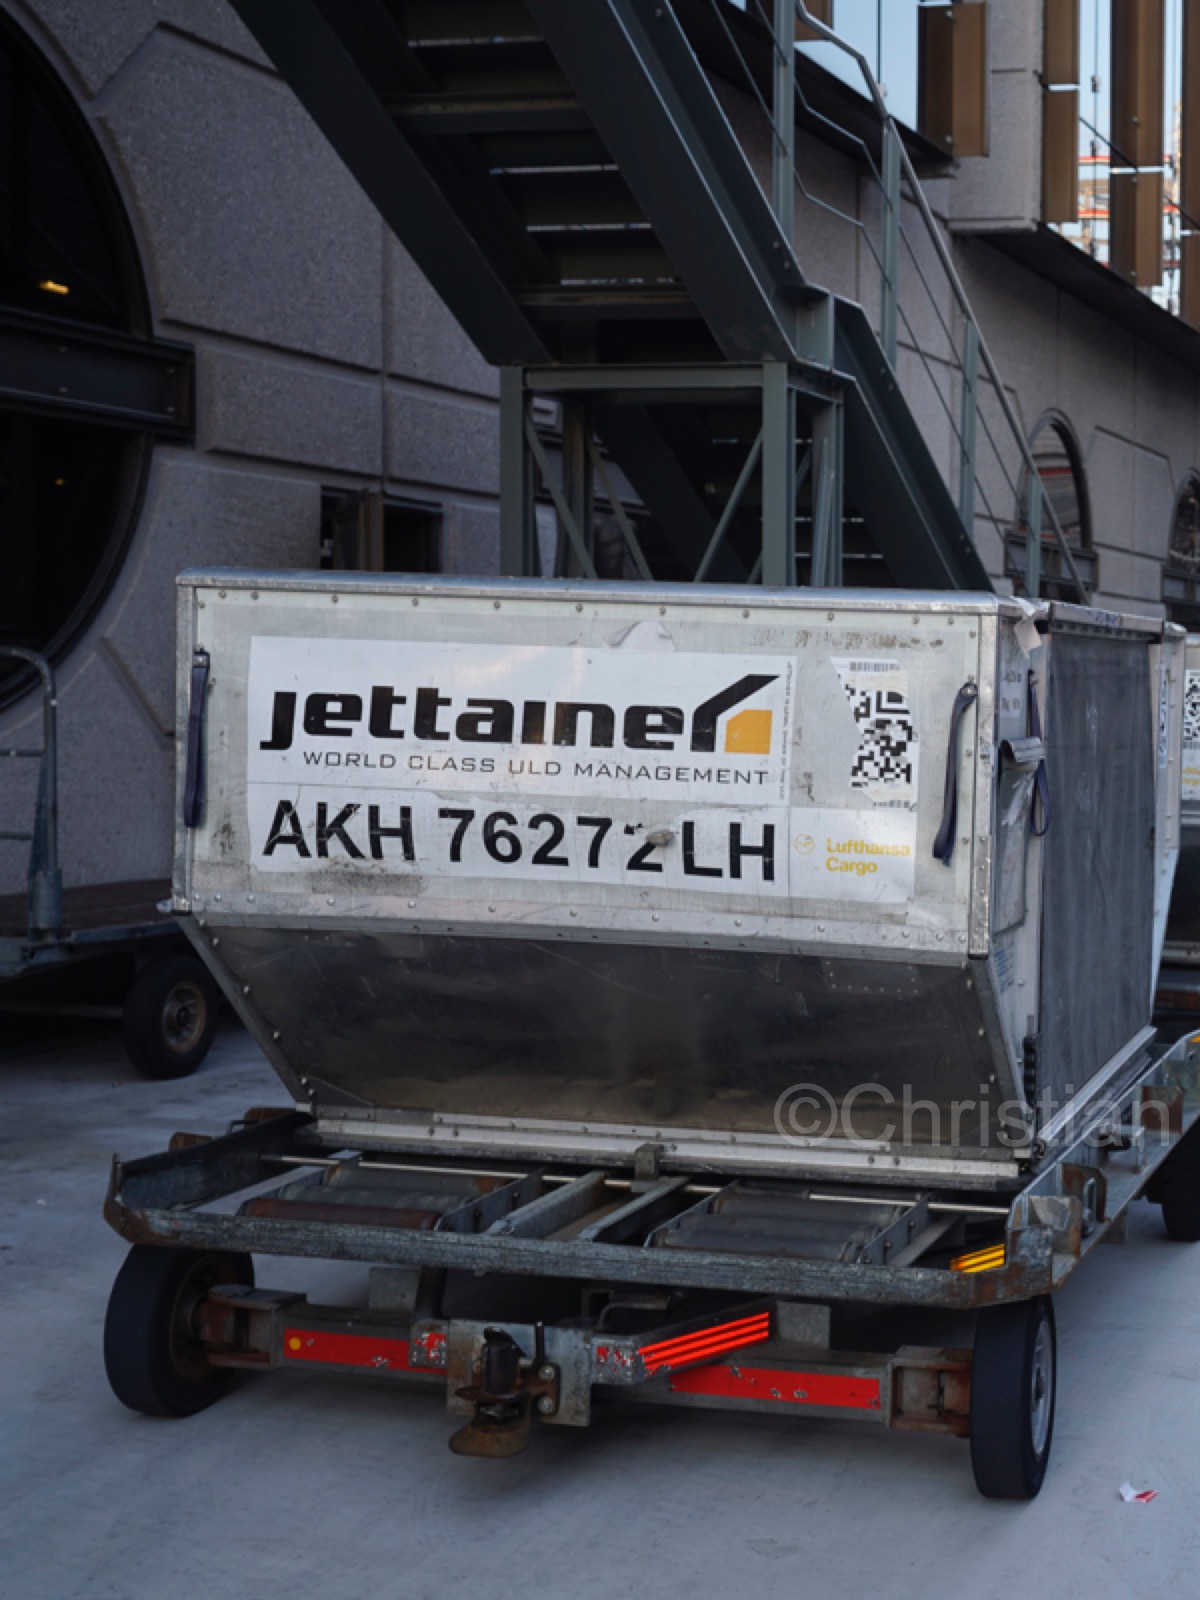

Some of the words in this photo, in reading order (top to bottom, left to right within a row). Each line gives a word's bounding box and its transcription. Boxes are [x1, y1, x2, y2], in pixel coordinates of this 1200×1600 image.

[303, 751, 397, 769] WORLD
[408, 755, 495, 773] CLASS
[508, 760, 561, 776] ULD
[574, 762, 769, 785] MANAGEMENT
[262, 800, 416, 861] AKH
[682, 820, 775, 881] LH
[826, 838, 911, 857] Lufthansa
[825, 857, 878, 876] Cargo
